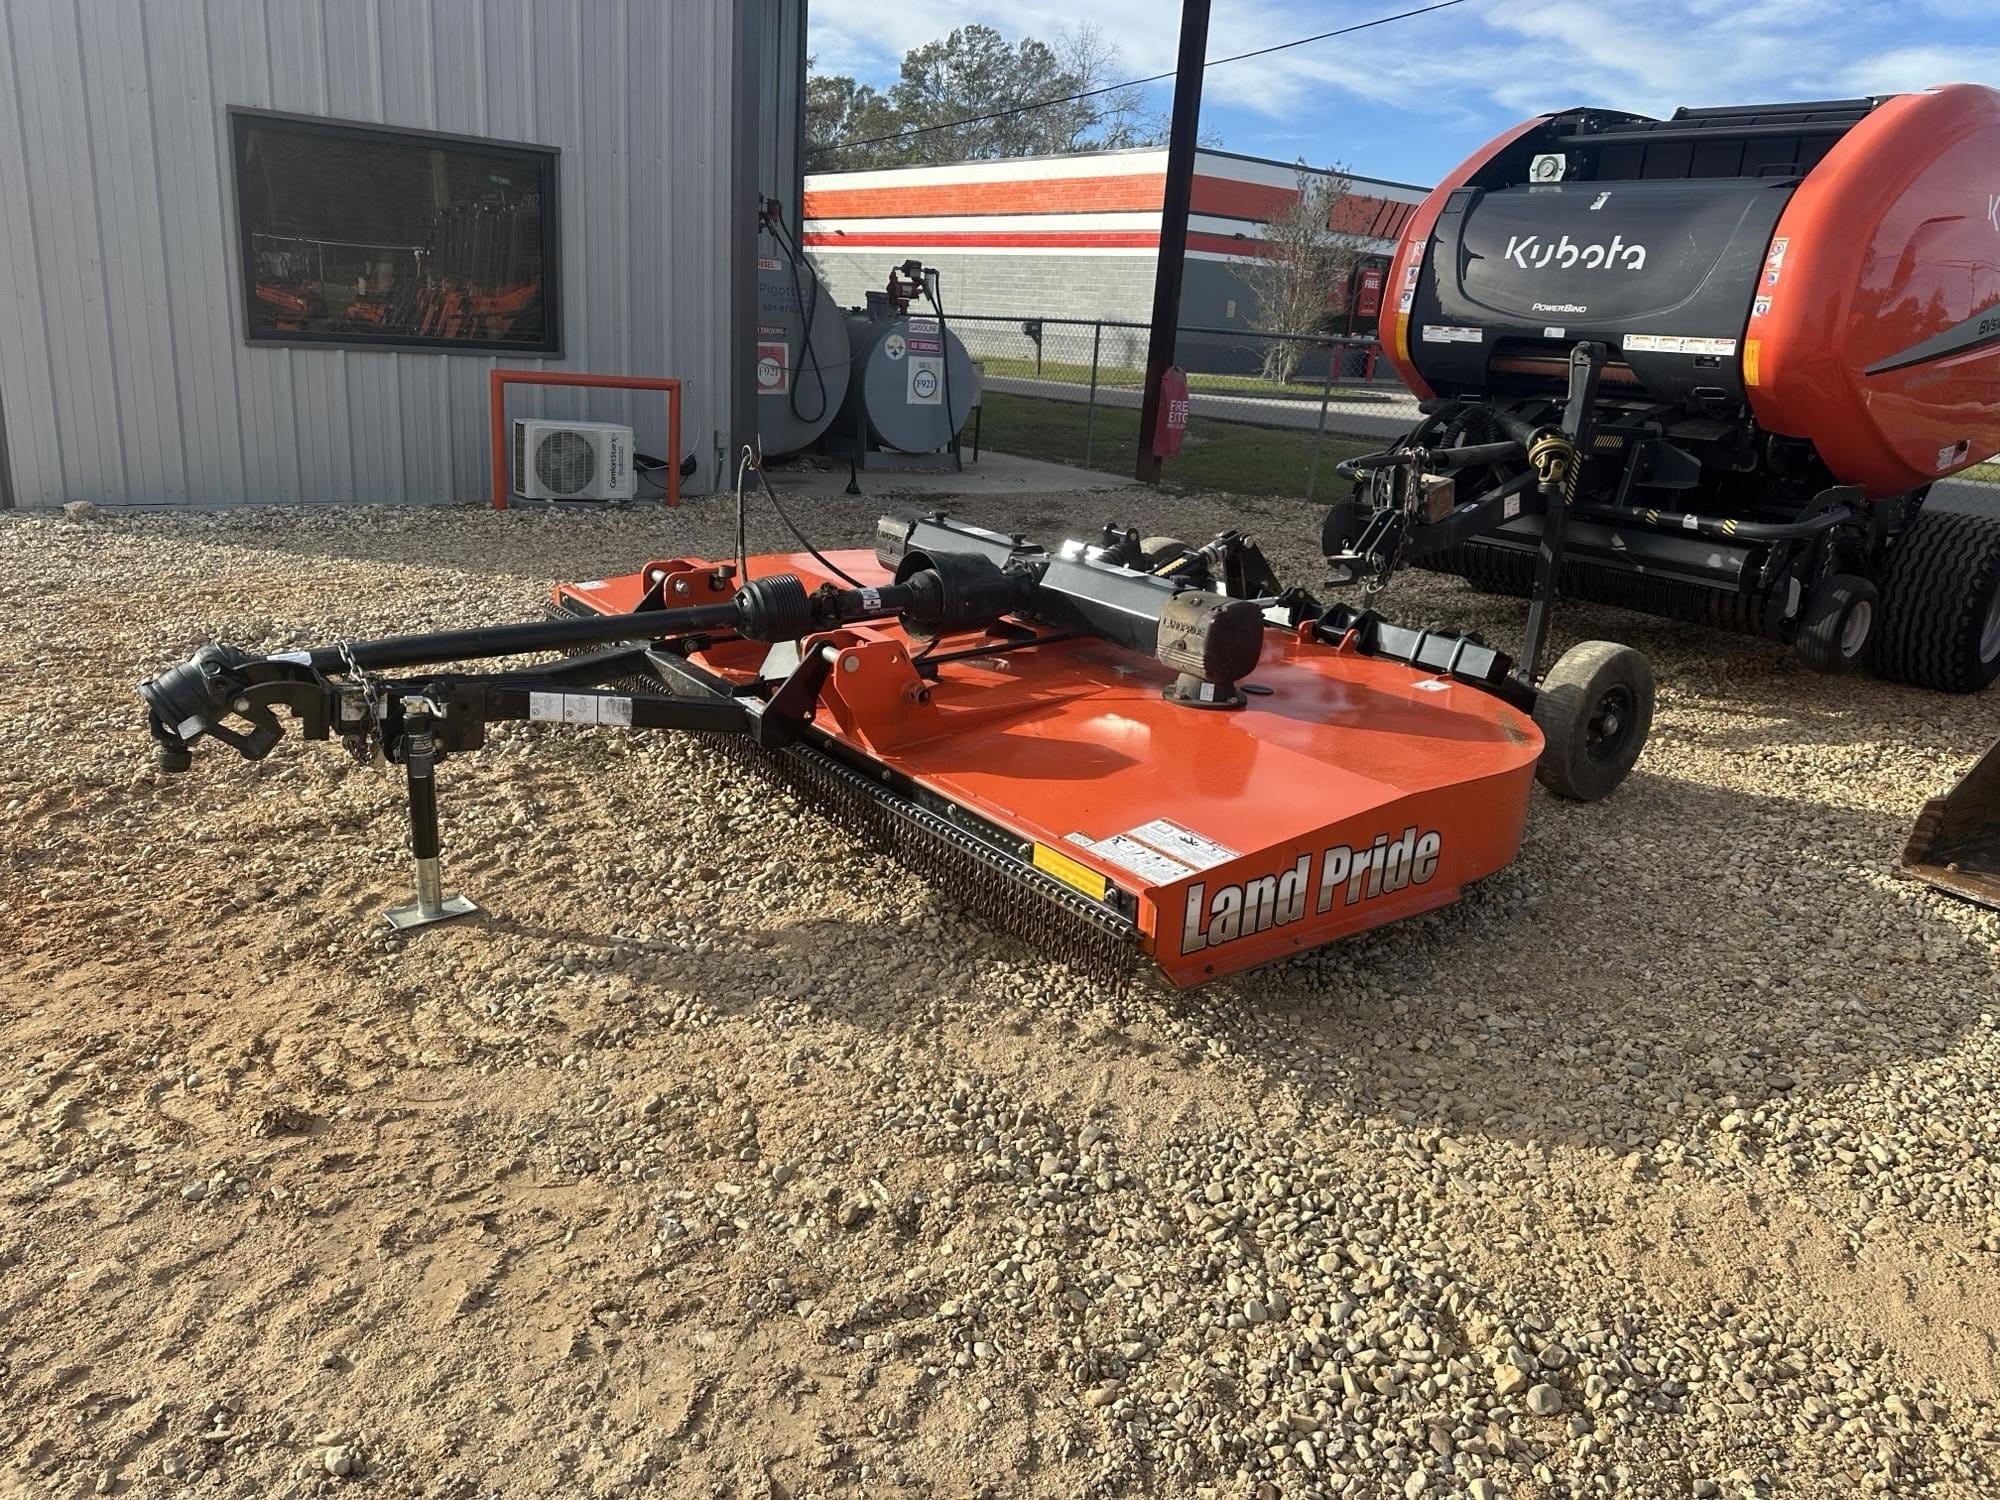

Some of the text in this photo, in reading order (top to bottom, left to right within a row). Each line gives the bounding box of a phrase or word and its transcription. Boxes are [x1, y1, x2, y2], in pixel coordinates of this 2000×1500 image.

[1503, 235, 1647, 270] Kubota
[759, 282, 796, 297] Pigott
[1364, 280, 1380, 289] FREE
[1181, 852, 1312, 956] Land
[1317, 825, 1442, 916] Pride
